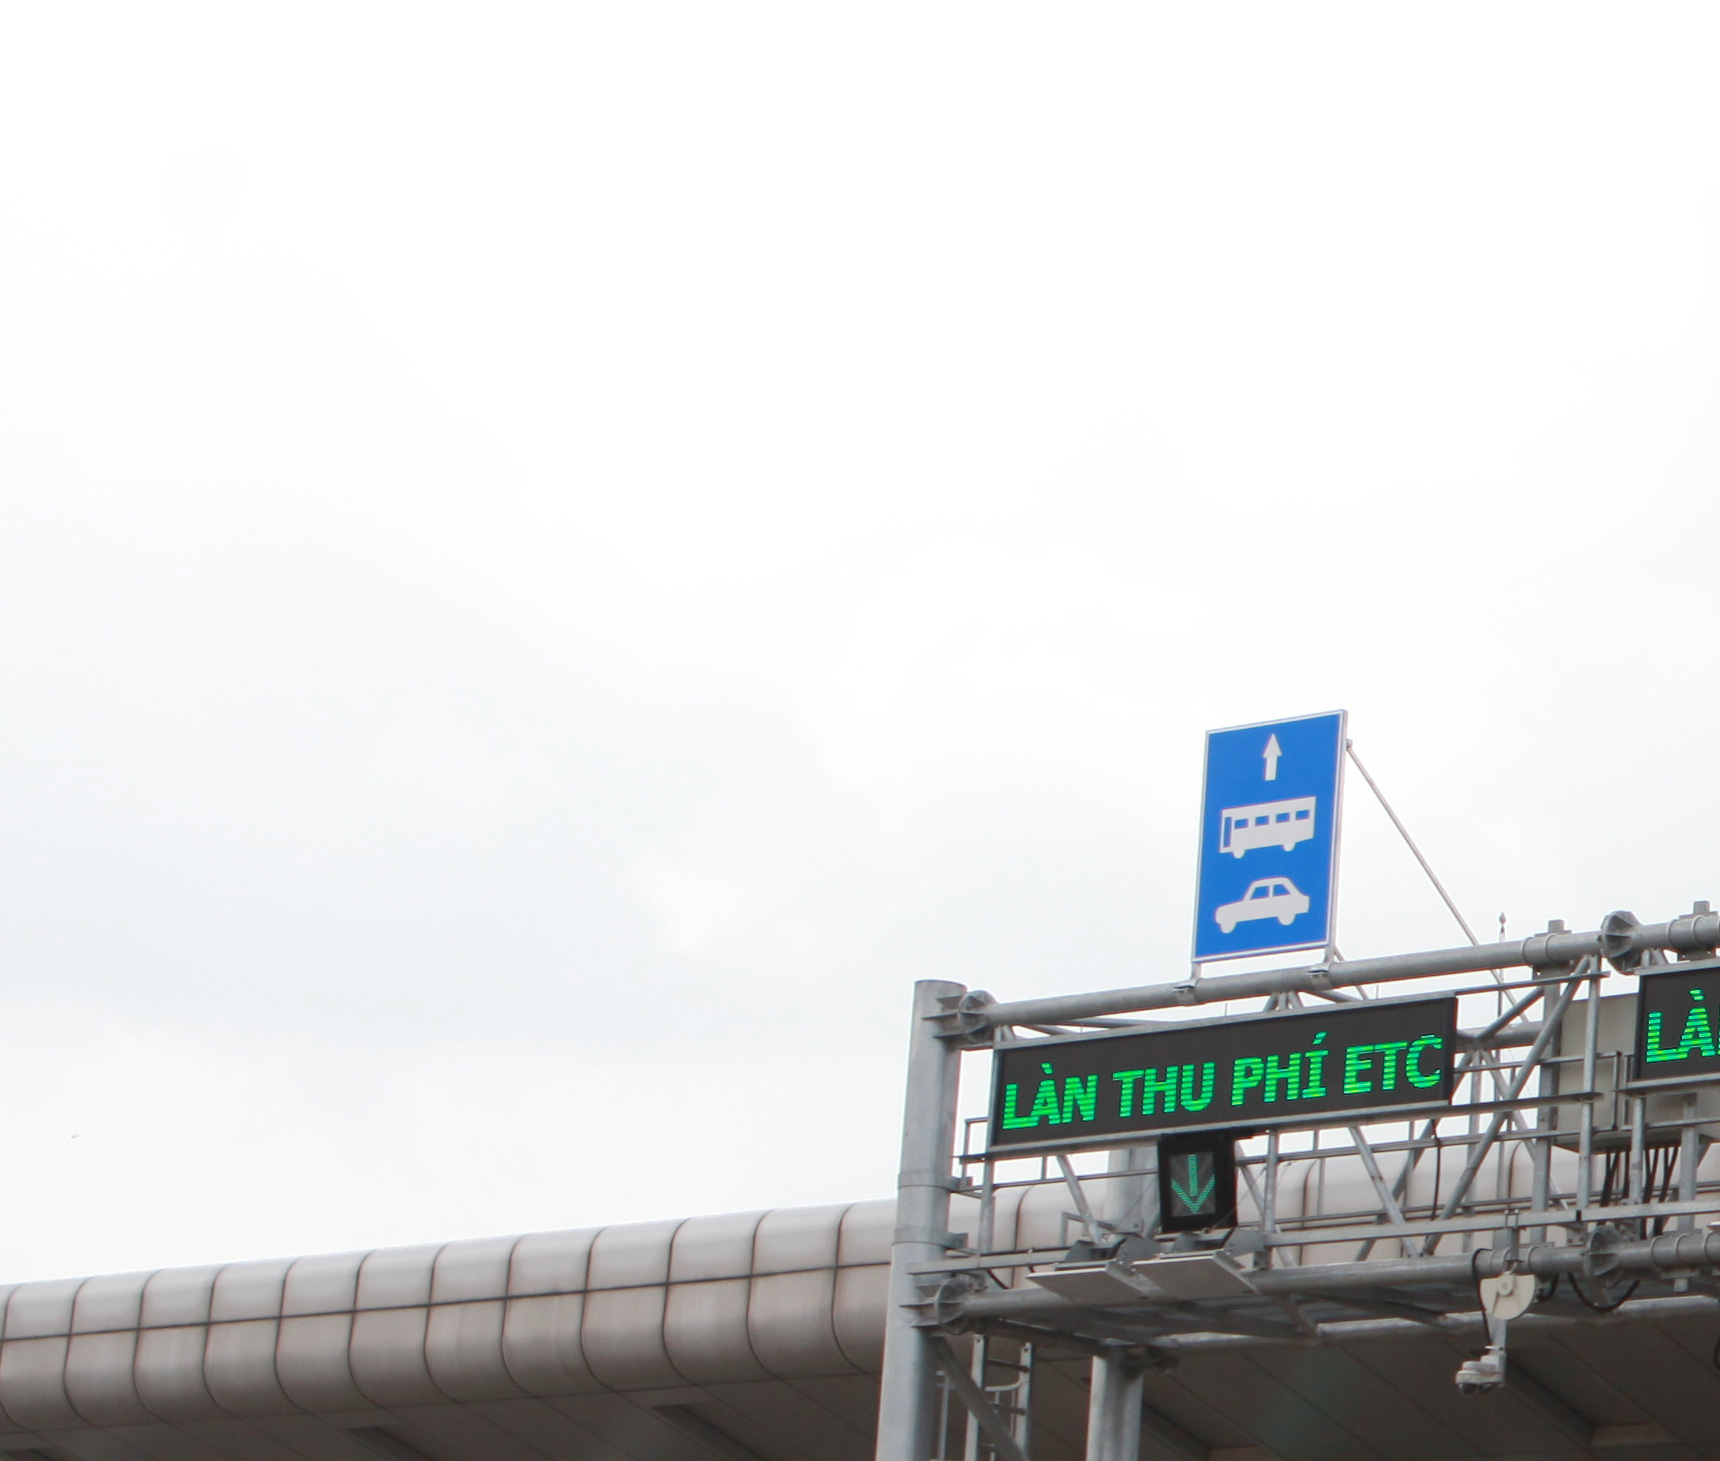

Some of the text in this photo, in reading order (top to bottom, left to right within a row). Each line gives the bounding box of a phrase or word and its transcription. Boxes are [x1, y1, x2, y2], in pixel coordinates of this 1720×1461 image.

[1002, 1031, 1443, 1130] LÀN THU PHÍ ETC
